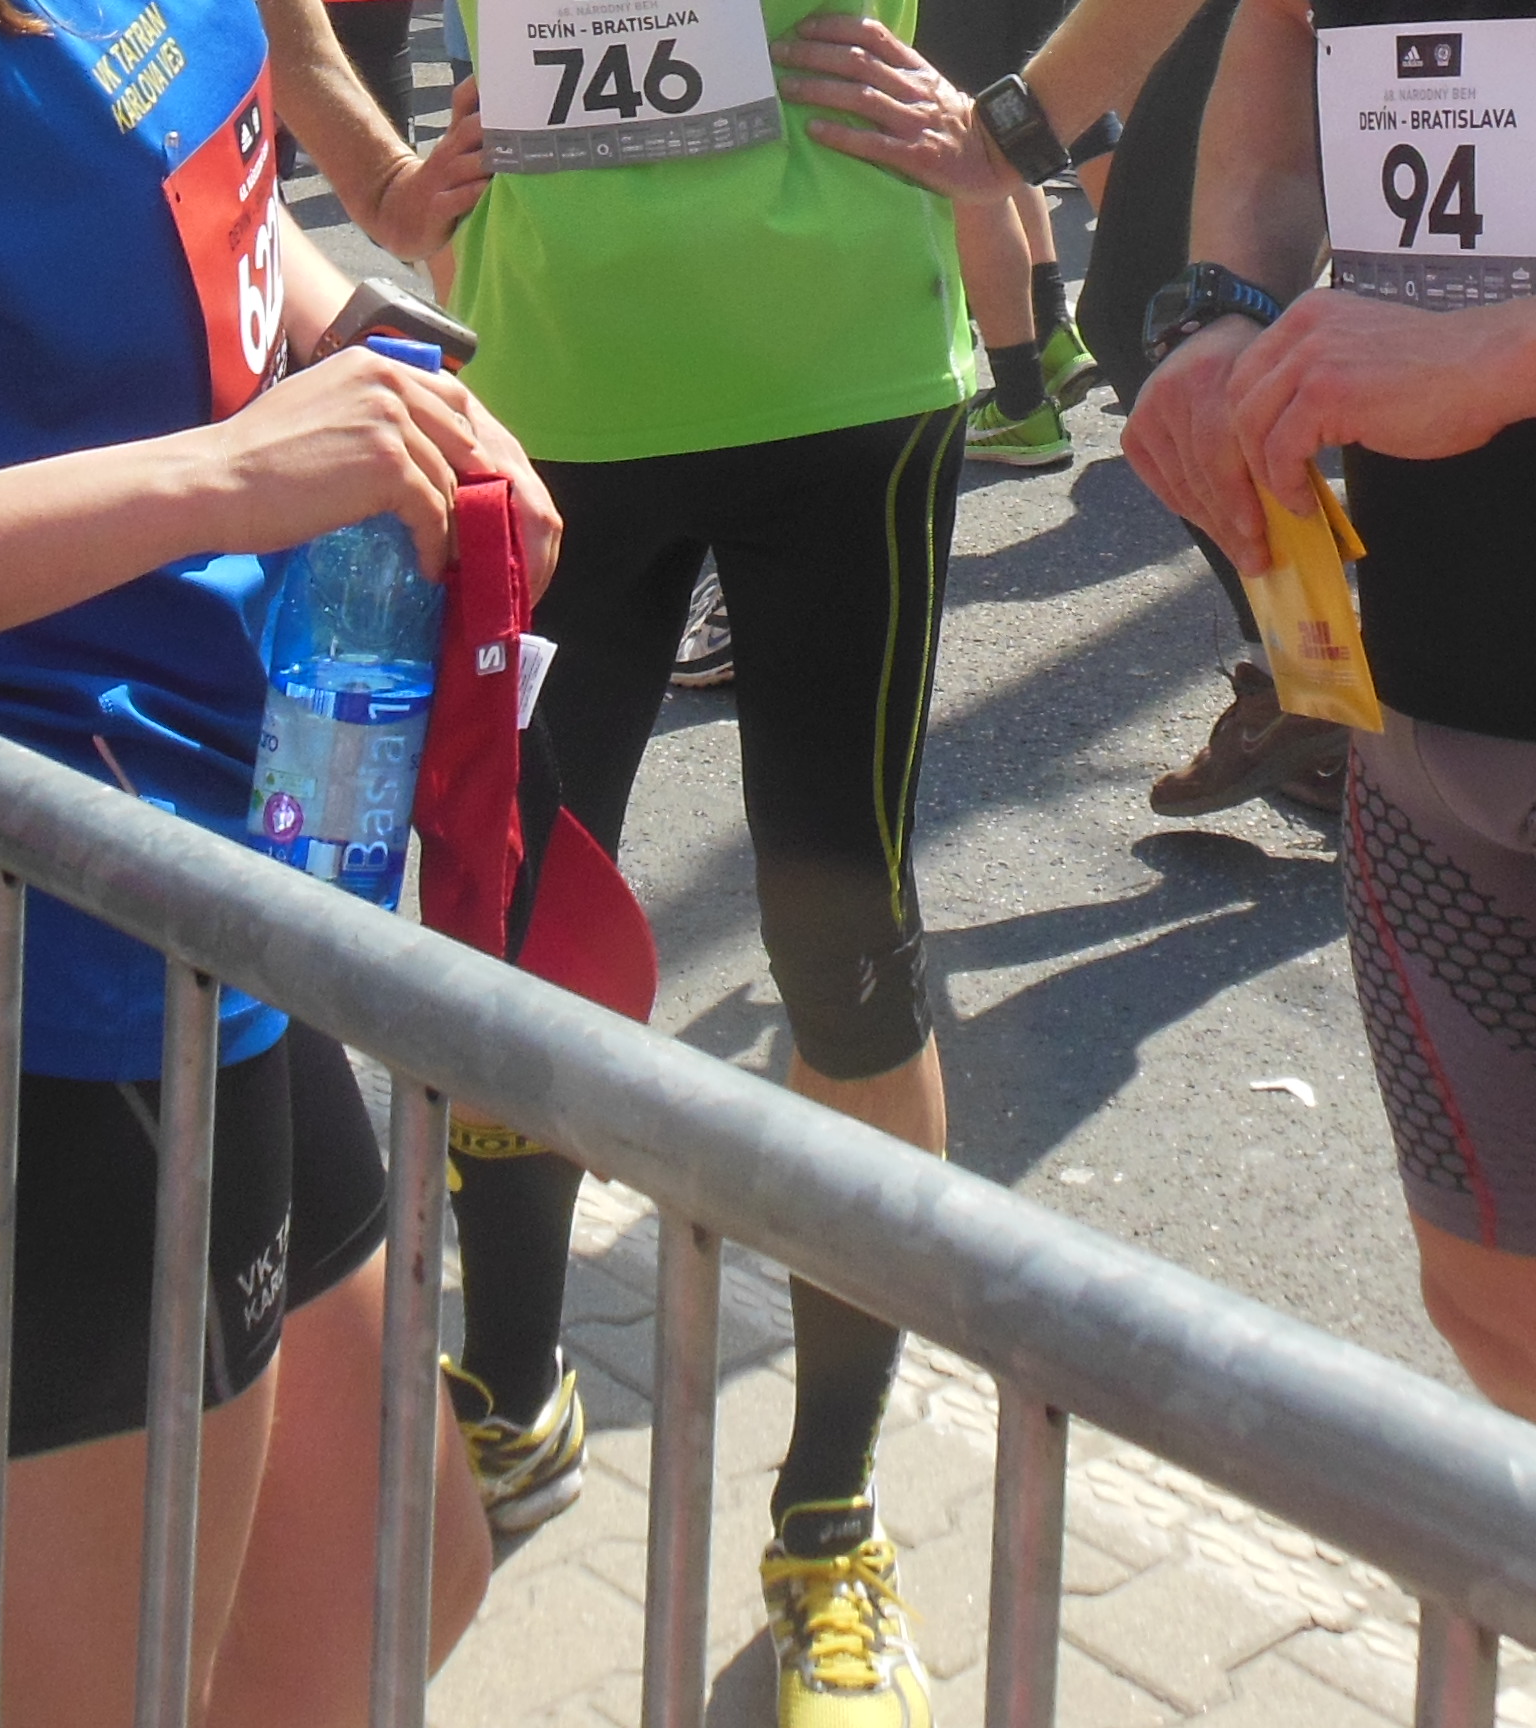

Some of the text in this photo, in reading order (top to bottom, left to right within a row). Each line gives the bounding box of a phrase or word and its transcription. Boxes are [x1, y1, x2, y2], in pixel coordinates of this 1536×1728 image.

[109, 1, 167, 74] TATRAN
[527, 19, 575, 40] DEVÍN
[593, 10, 699, 36] BRATISLAVA
[532, 39, 703, 126] 746
[1452, 87, 1476, 100] BEH
[1359, 105, 1397, 130] DEVÍN
[1411, 109, 1517, 129] BRATISLAVA
[1382, 143, 1483, 249] 94
